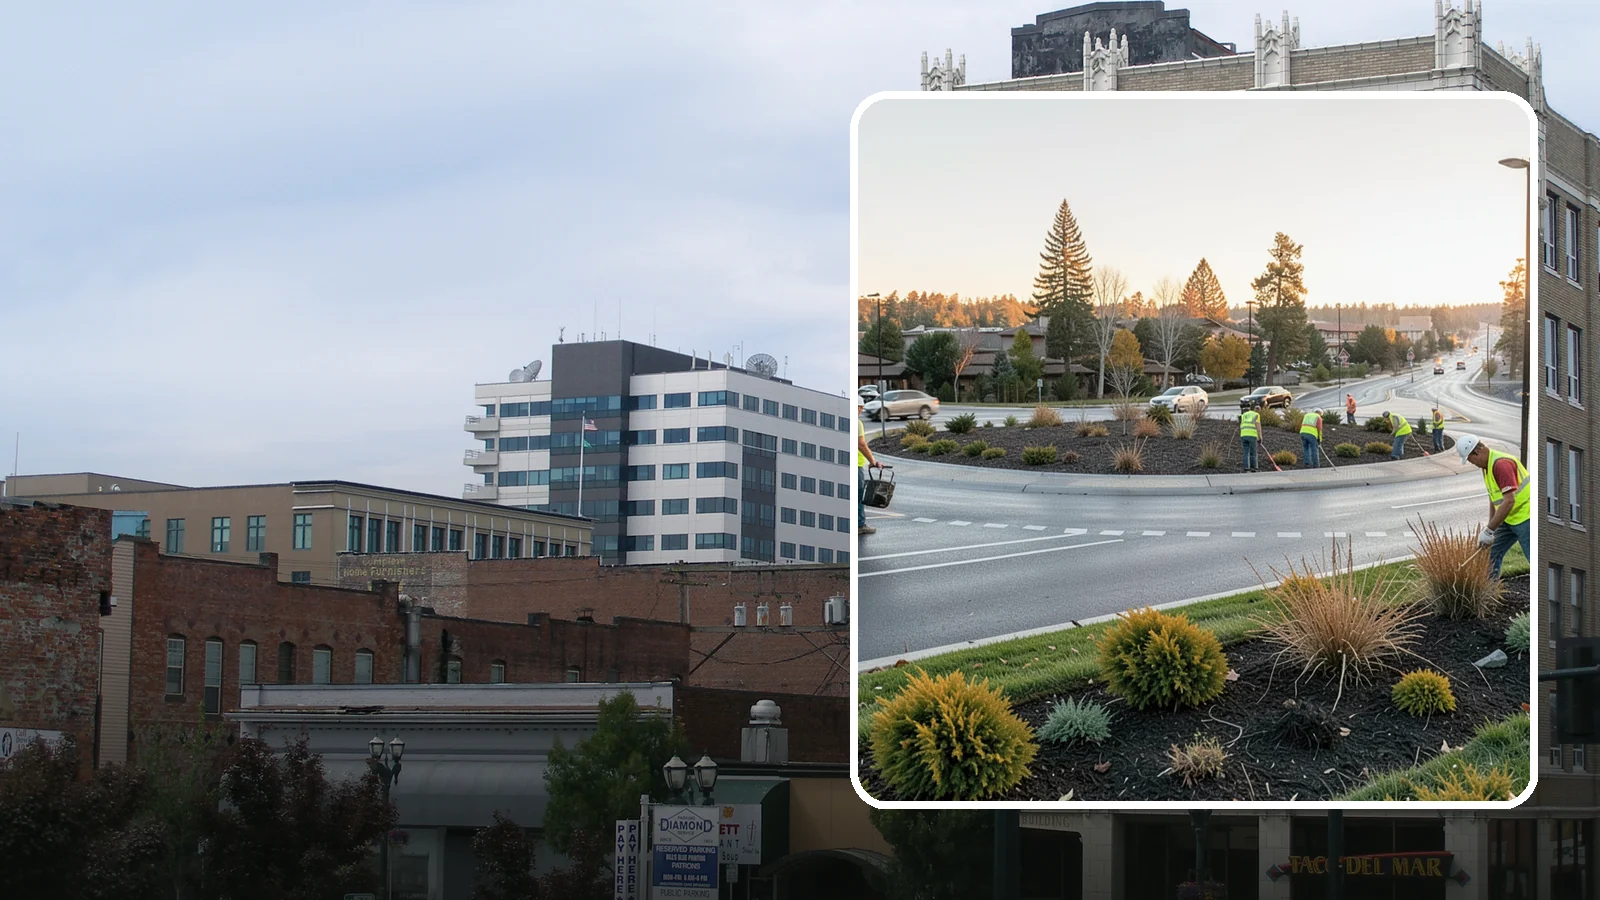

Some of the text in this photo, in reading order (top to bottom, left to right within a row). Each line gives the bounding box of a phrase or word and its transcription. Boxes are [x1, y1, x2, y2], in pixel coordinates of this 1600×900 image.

[660, 818, 713, 833] DIAMOND
[1022, 815, 1070, 828] BUILDING
[655, 845, 716, 854] RESERVED PARKING
[617, 825, 625, 893] PAY HERE
[671, 862, 701, 870] PATRONS
[1346, 856, 1384, 875] DEL
[1392, 857, 1443, 877] MAR
[628, 856, 636, 893] HERE
[660, 888, 710, 898] PUBLIC PARKING
